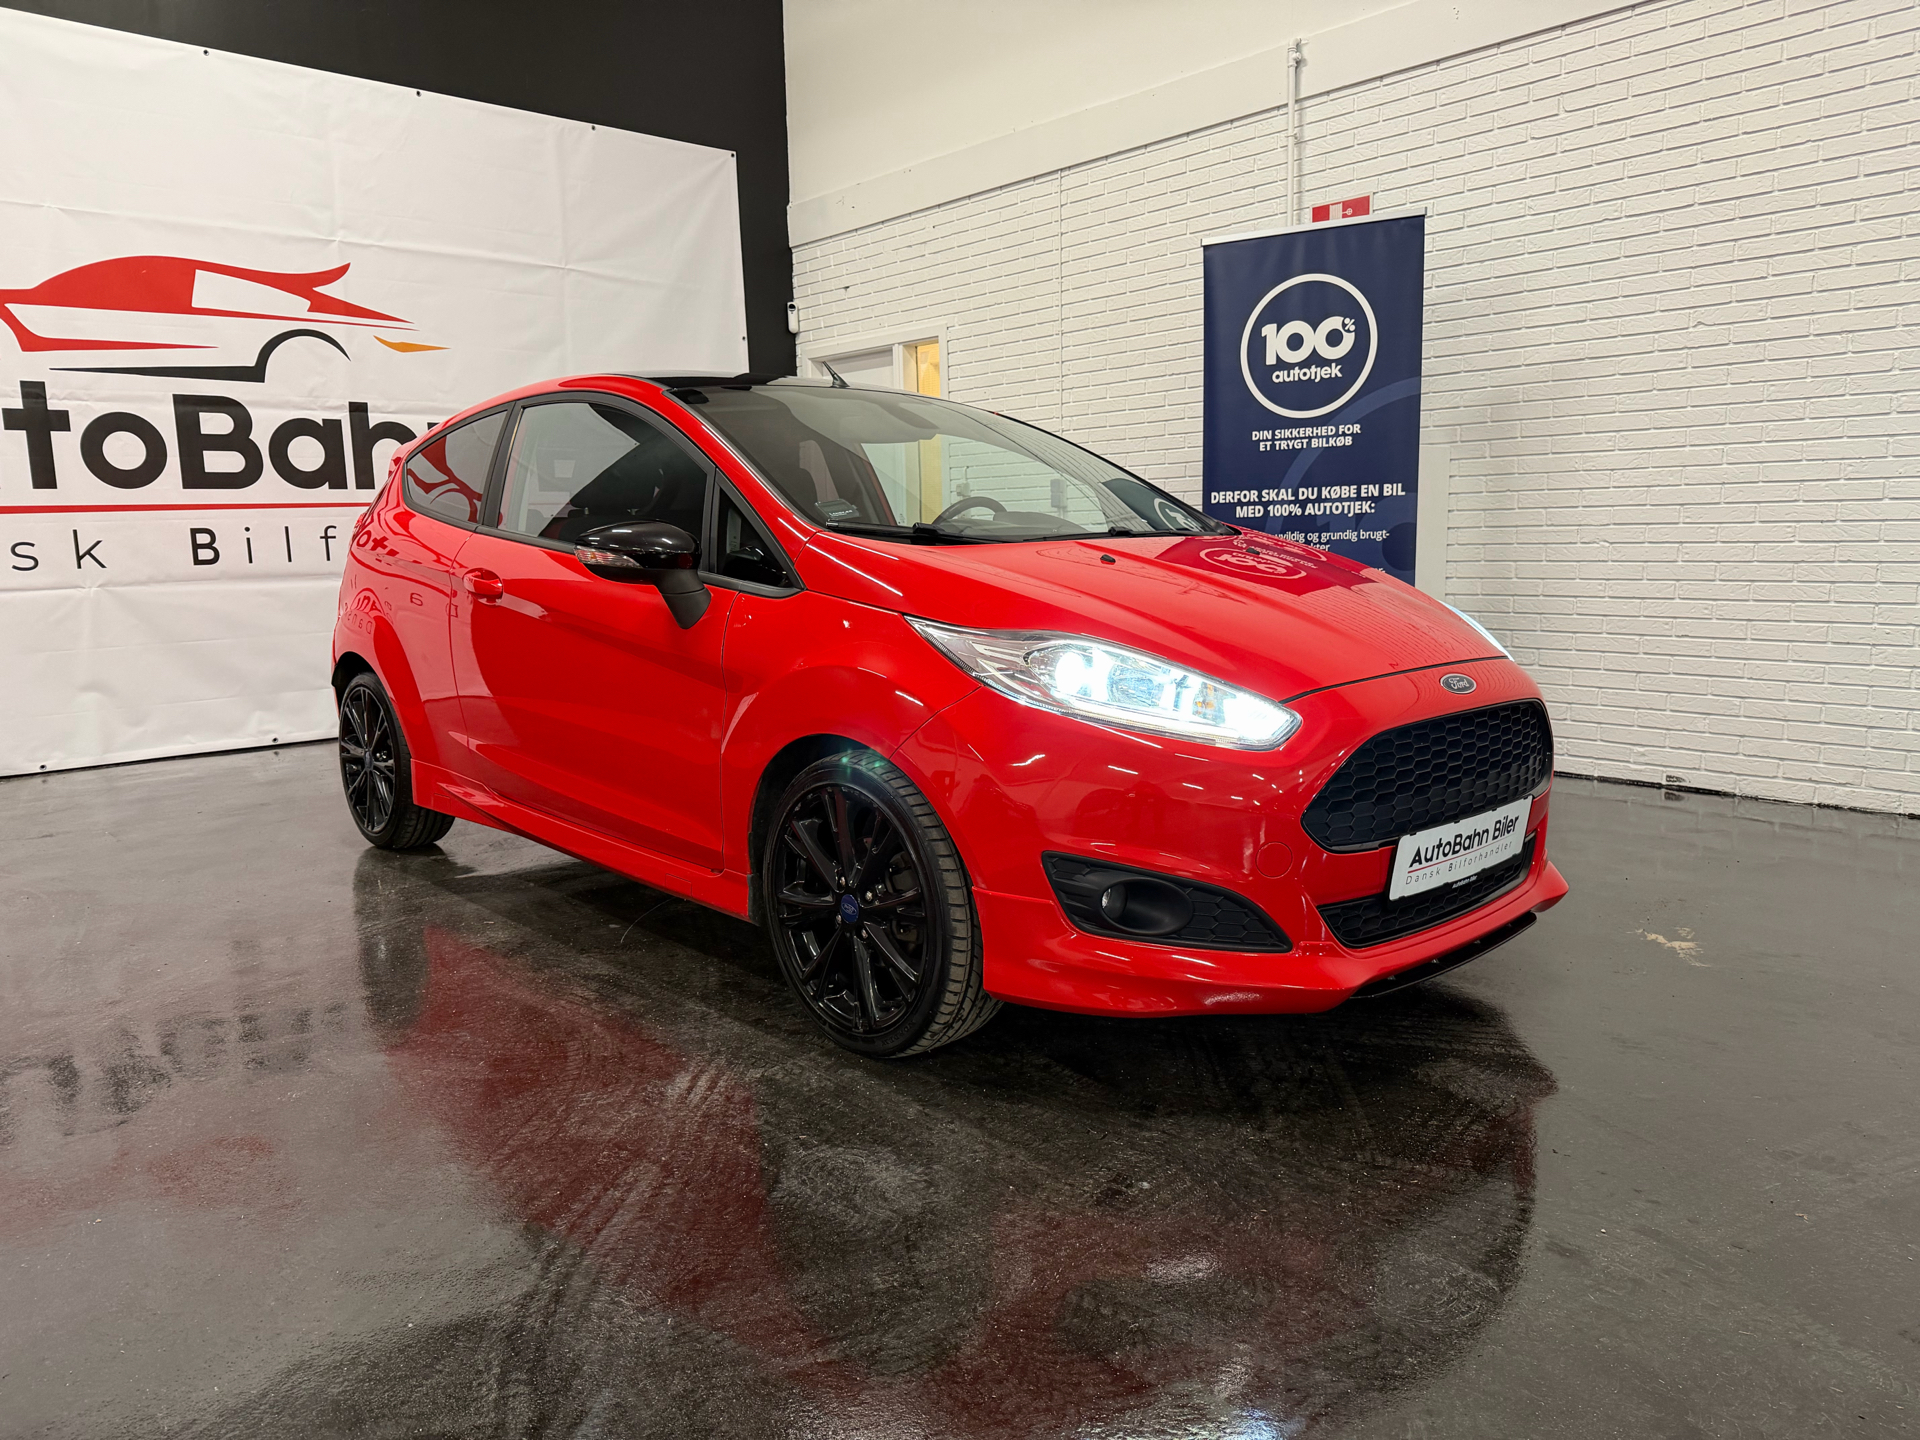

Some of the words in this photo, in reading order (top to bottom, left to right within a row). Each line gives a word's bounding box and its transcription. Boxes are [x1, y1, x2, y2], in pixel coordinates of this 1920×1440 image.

[1271, 362, 1343, 383] autotjek
[1, 380, 440, 490] toBah
[1251, 430, 1272, 441] DIN
[1274, 425, 1336, 439] SIKKERHED
[1338, 423, 1361, 435] FOR
[1259, 441, 1272, 452] ET
[1274, 438, 1309, 451] TRYGT
[1311, 435, 1353, 449] BILKØB
[1210, 490, 1259, 504] DERFOR
[1261, 488, 1295, 502] SKAL
[1298, 487, 1318, 500] DU
[1321, 485, 1357, 499] KØBE
[1360, 484, 1379, 497] EN
[1383, 483, 1406, 496] BIL
[1235, 505, 1264, 518] MED
[1267, 503, 1302, 517] 100%
[1304, 500, 1376, 517] AUTOTJEK:
[1307, 532, 1319, 543] og
[1321, 529, 1358, 543] grundig
[1360, 529, 1390, 541] brugt-
[1448, 677, 1470, 689] Ford
[1408, 827, 1490, 868] AutoBahn
[1492, 815, 1519, 840] Biler
[1405, 867, 1441, 885] Dansk
[1448, 841, 1512, 872] Bilforhandler
